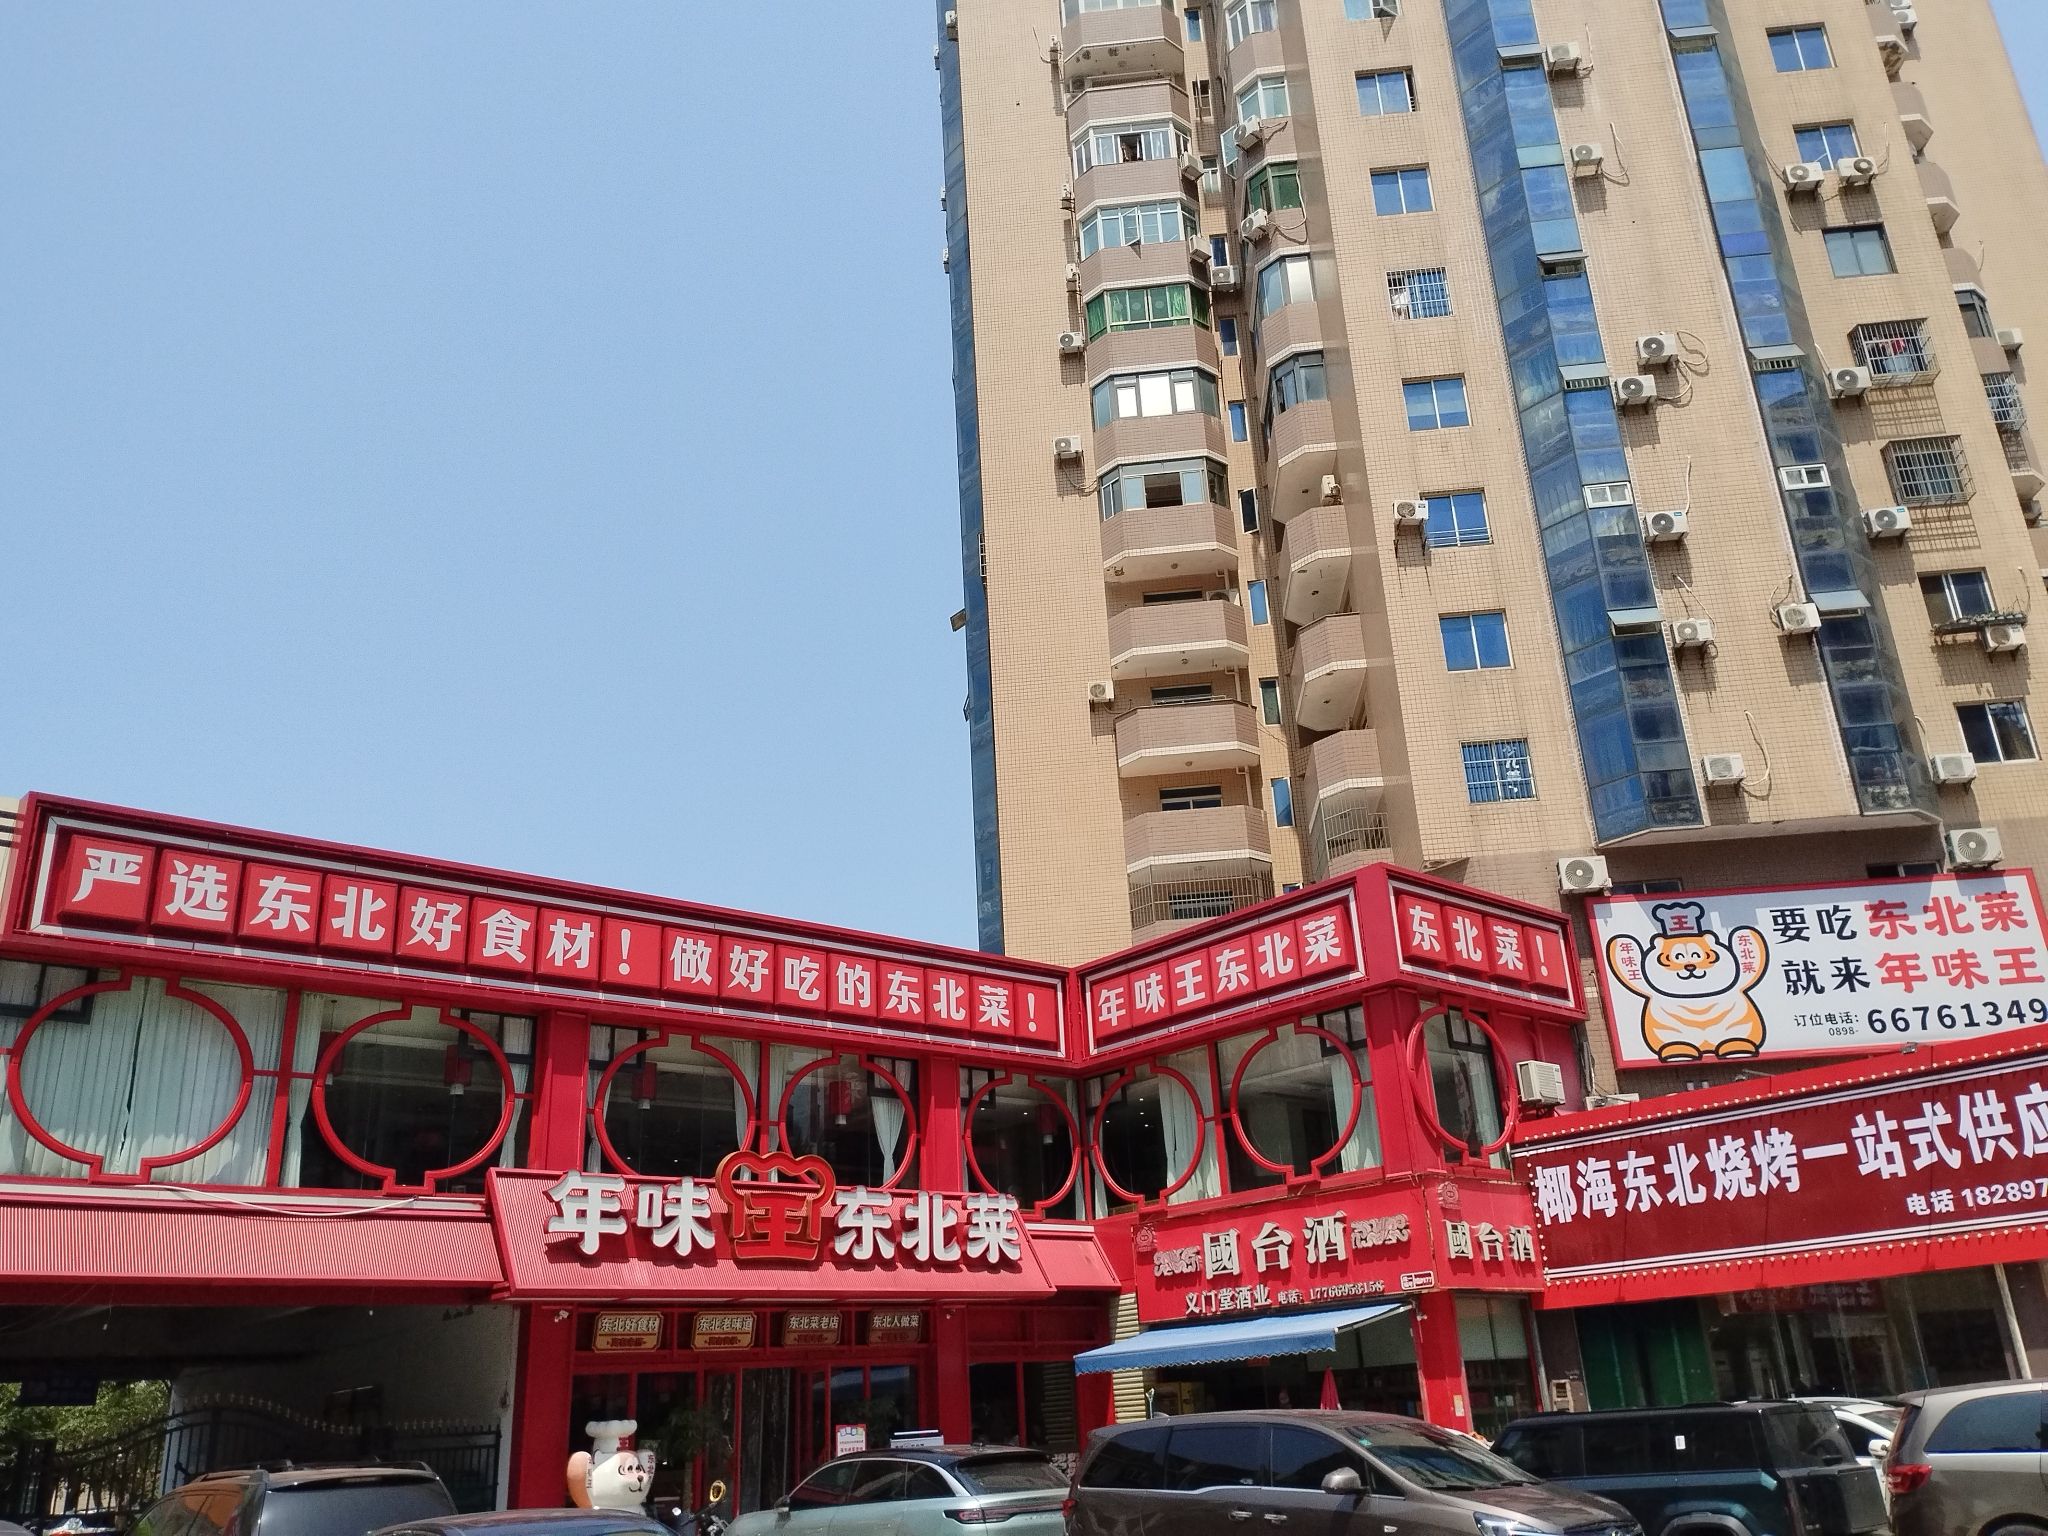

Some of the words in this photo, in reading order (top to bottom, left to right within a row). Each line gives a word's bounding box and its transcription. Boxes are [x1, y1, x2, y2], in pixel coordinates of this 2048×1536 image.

[1669, 915, 1694, 931] 王
[1770, 890, 2030, 944] 要吃东北菜
[1409, 905, 1550, 976] 东北菜！
[1737, 934, 1757, 974] 东北菜
[1097, 914, 1342, 1027] 年味王东北菜
[1619, 942, 1642, 981] 年味王
[1781, 946, 2045, 996] 就来年味王
[1867, 998, 2048, 1033] 66761349
[1906, 1189, 1955, 1216] 电话
[1185, 1284, 1272, 1314] 义门堂酒业
[600, 1316, 659, 1332] 东北好食材
[698, 1316, 753, 1331] 东北老味道
[788, 1315, 840, 1329] 东北菜老店
